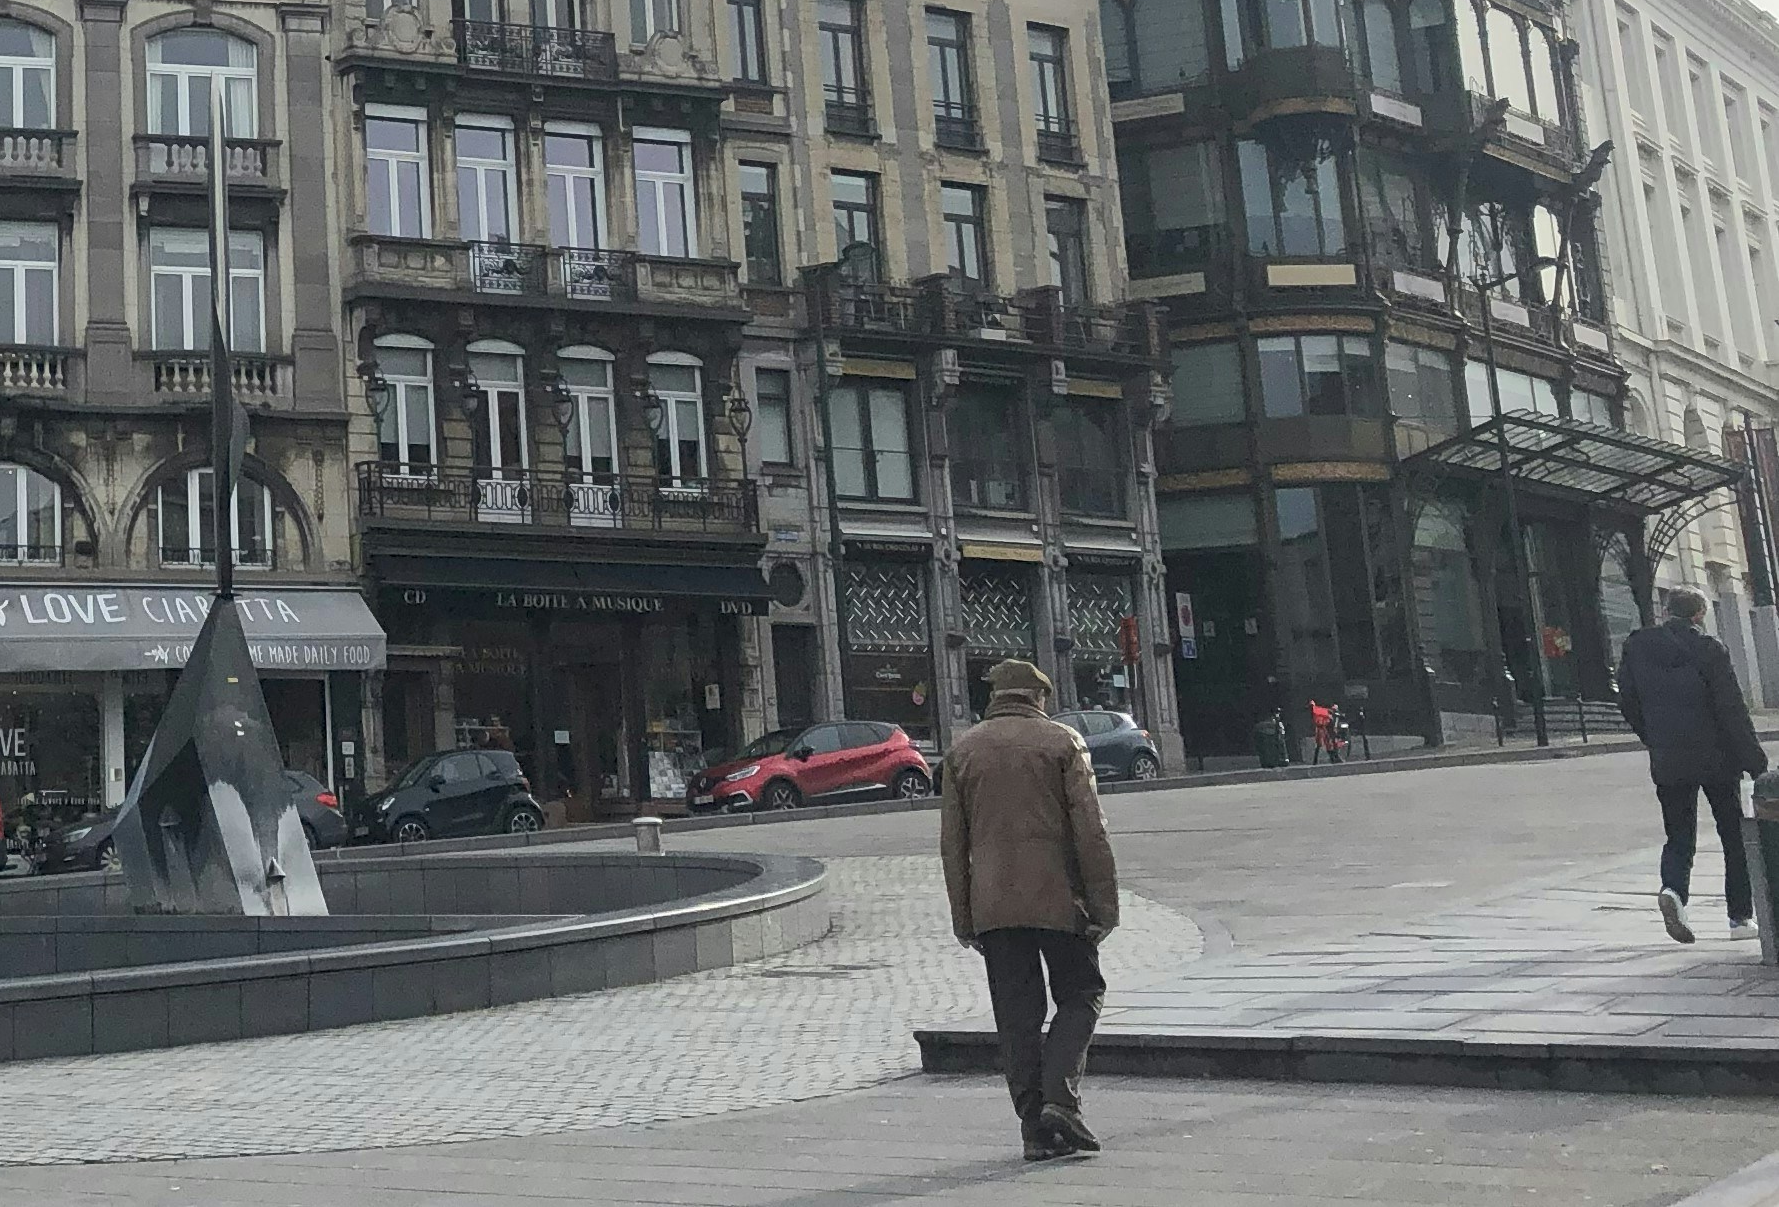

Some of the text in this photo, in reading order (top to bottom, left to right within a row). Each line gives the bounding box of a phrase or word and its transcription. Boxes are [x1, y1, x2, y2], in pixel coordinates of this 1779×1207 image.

[403, 590, 427, 605] CD
[497, 593, 517, 608] LA
[522, 594, 570, 609] BOITE
[592, 596, 665, 613] MUSIQUE
[721, 600, 753, 615] DVD
[20, 593, 301, 624] LOVE CIABTTA
[268, 645, 298, 664] MADE
[304, 645, 337, 665] DAILY
[343, 645, 371, 664] FOOD
